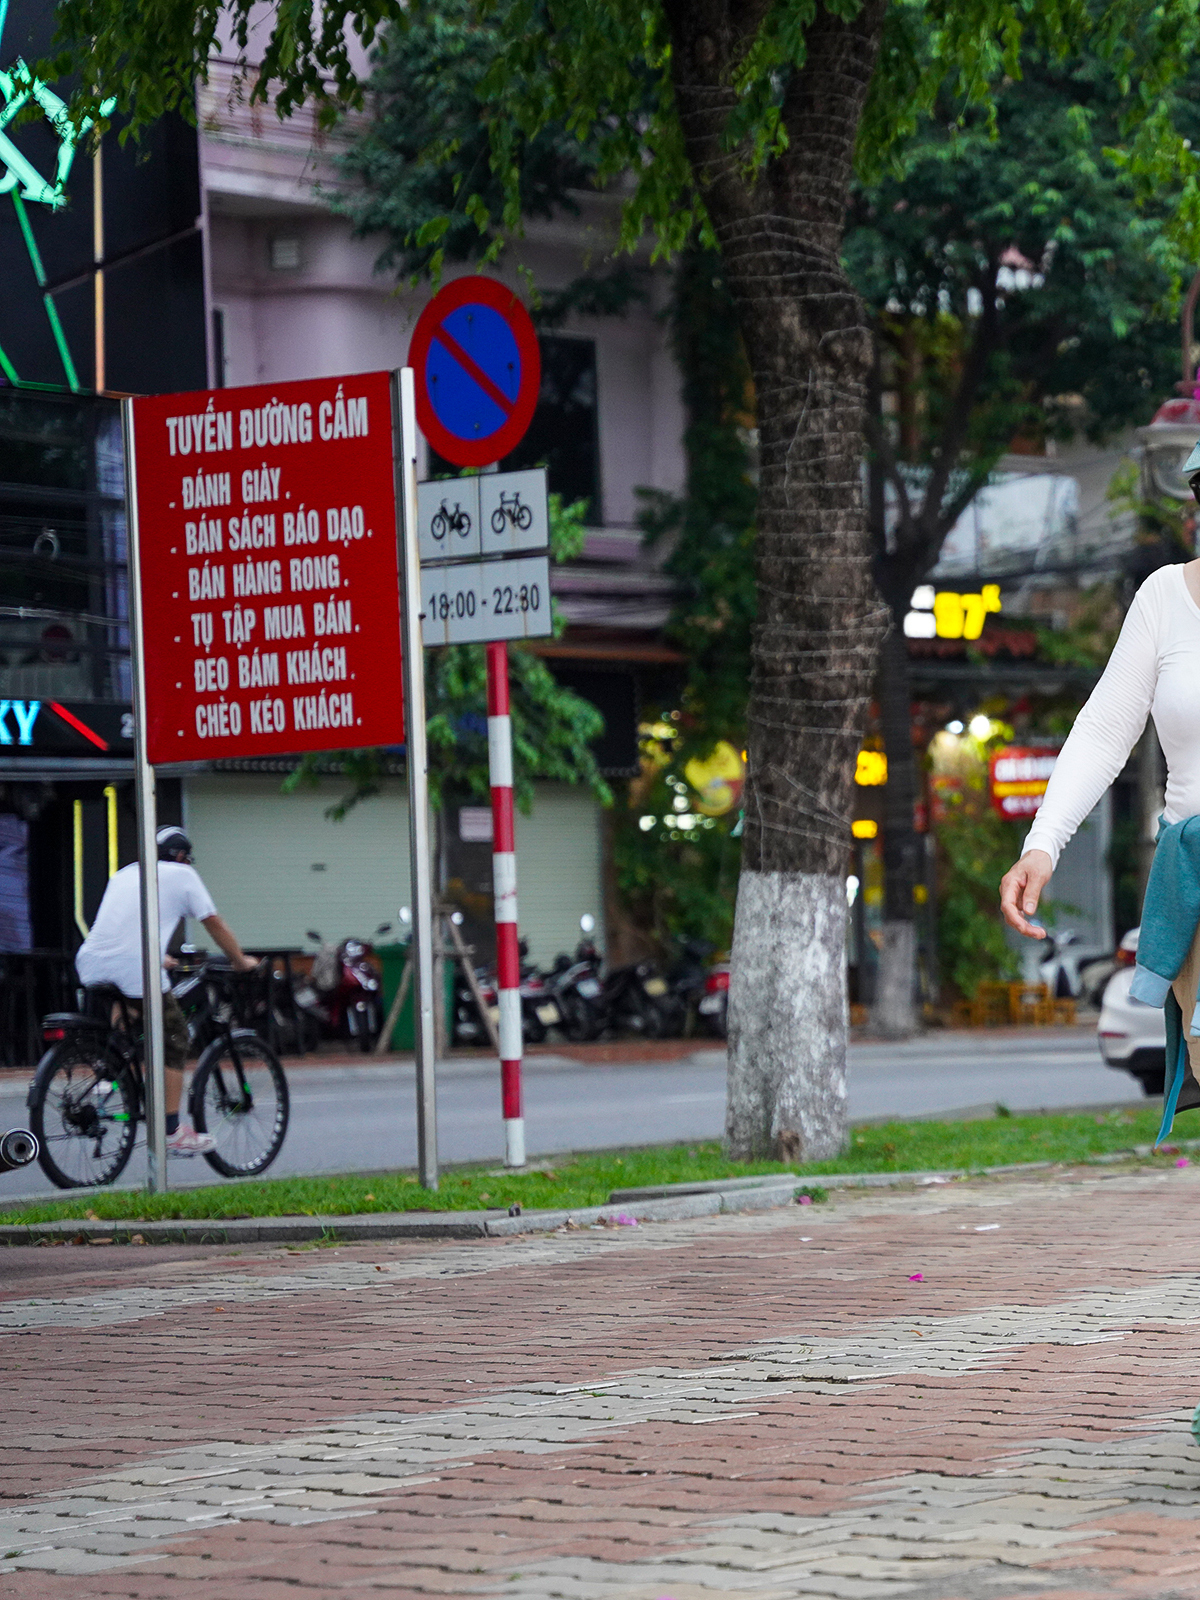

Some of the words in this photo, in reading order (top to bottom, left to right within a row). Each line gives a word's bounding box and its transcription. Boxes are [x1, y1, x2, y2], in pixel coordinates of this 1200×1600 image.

[166, 397, 233, 456] TUYẾN
[239, 397, 312, 448] ĐƯỜNG
[319, 383, 368, 441] CẤM
[182, 467, 231, 510] ĐÁNH
[185, 513, 223, 555] BÁN
[228, 508, 276, 551] SÁCH
[283, 503, 320, 546] BÁO
[188, 559, 225, 601] BÁN
[232, 555, 282, 597] HÀNG
[429, 590, 476, 621] 18:00
[493, 582, 540, 614] 22:30
[191, 612, 214, 653] TỤ
[222, 603, 256, 649] TẬP
[263, 604, 305, 641] MUA
[194, 656, 229, 693] ĐEO
[238, 647, 279, 689] BÁM
[195, 695, 242, 738] CHÈO
[250, 693, 285, 734] KÉO
